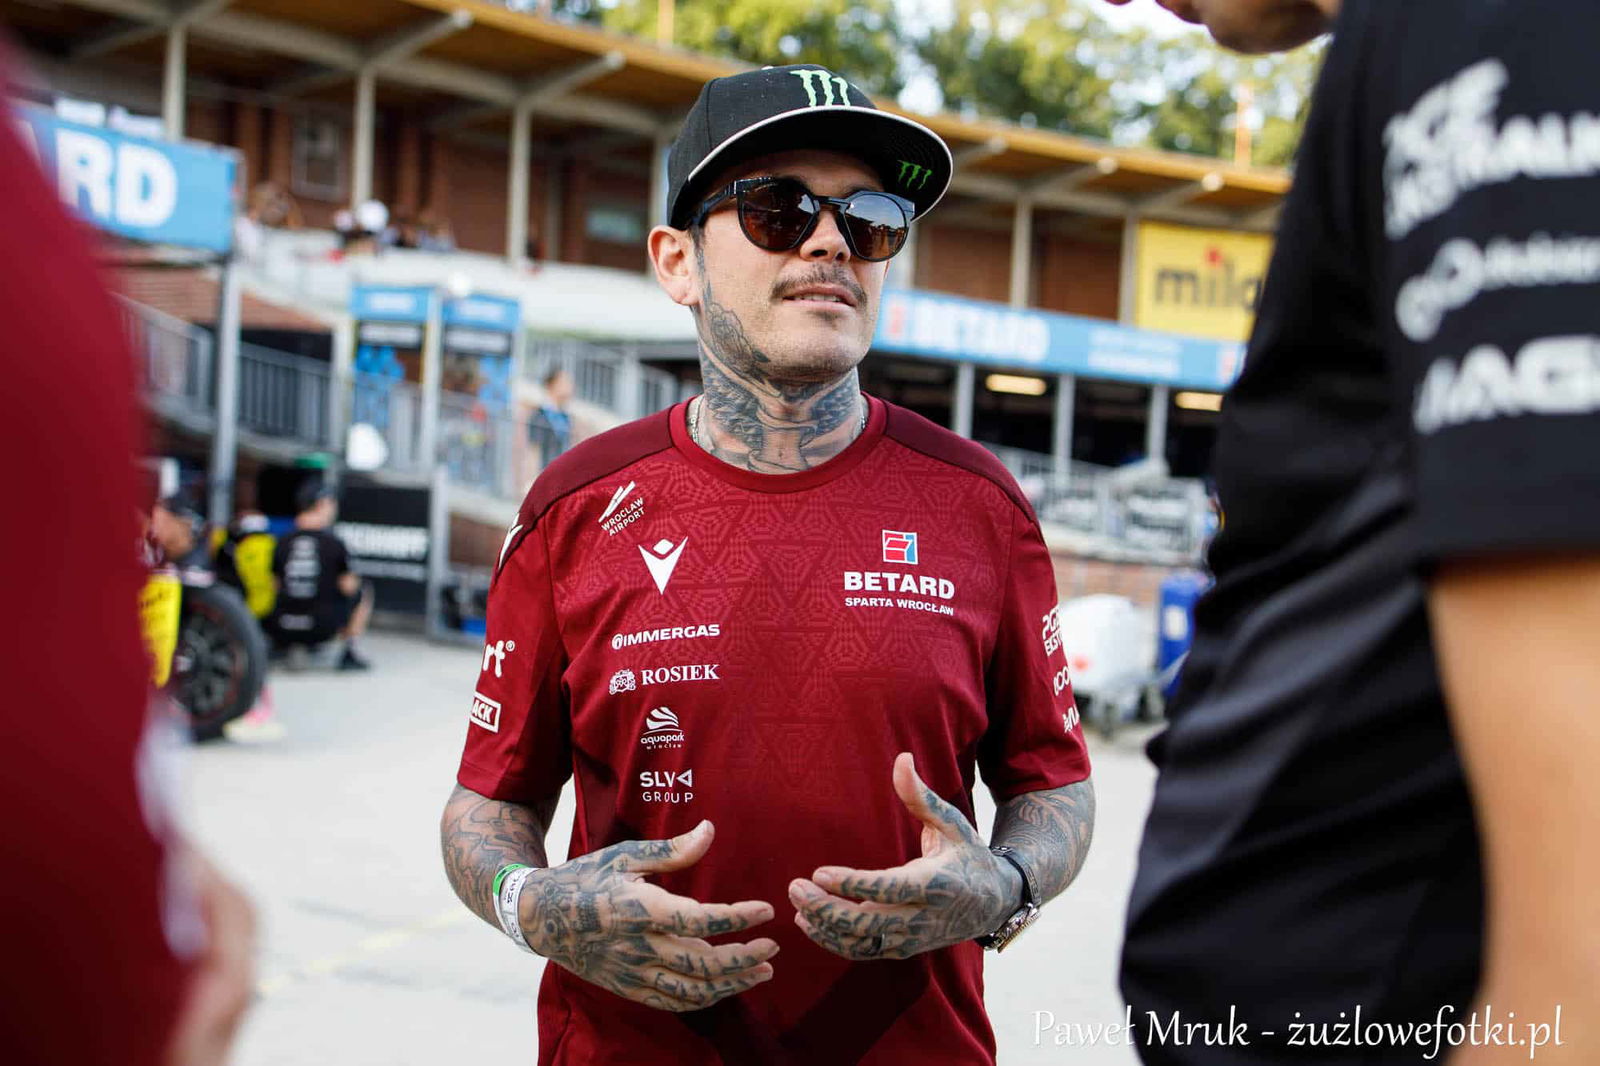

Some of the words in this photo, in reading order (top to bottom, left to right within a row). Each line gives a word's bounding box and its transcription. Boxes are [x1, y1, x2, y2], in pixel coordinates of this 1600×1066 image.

[601, 497, 644, 531] WROCLAW
[609, 507, 645, 537] AIRPORT
[843, 571, 955, 600] BETARD
[845, 597, 894, 608] SPARTA
[896, 598, 954, 617] WROCŁAW
[623, 624, 720, 647] IMMERGAS
[640, 664, 720, 686] ROSIEK
[640, 732, 685, 745] aquapark
[642, 791, 694, 803] GROUP
